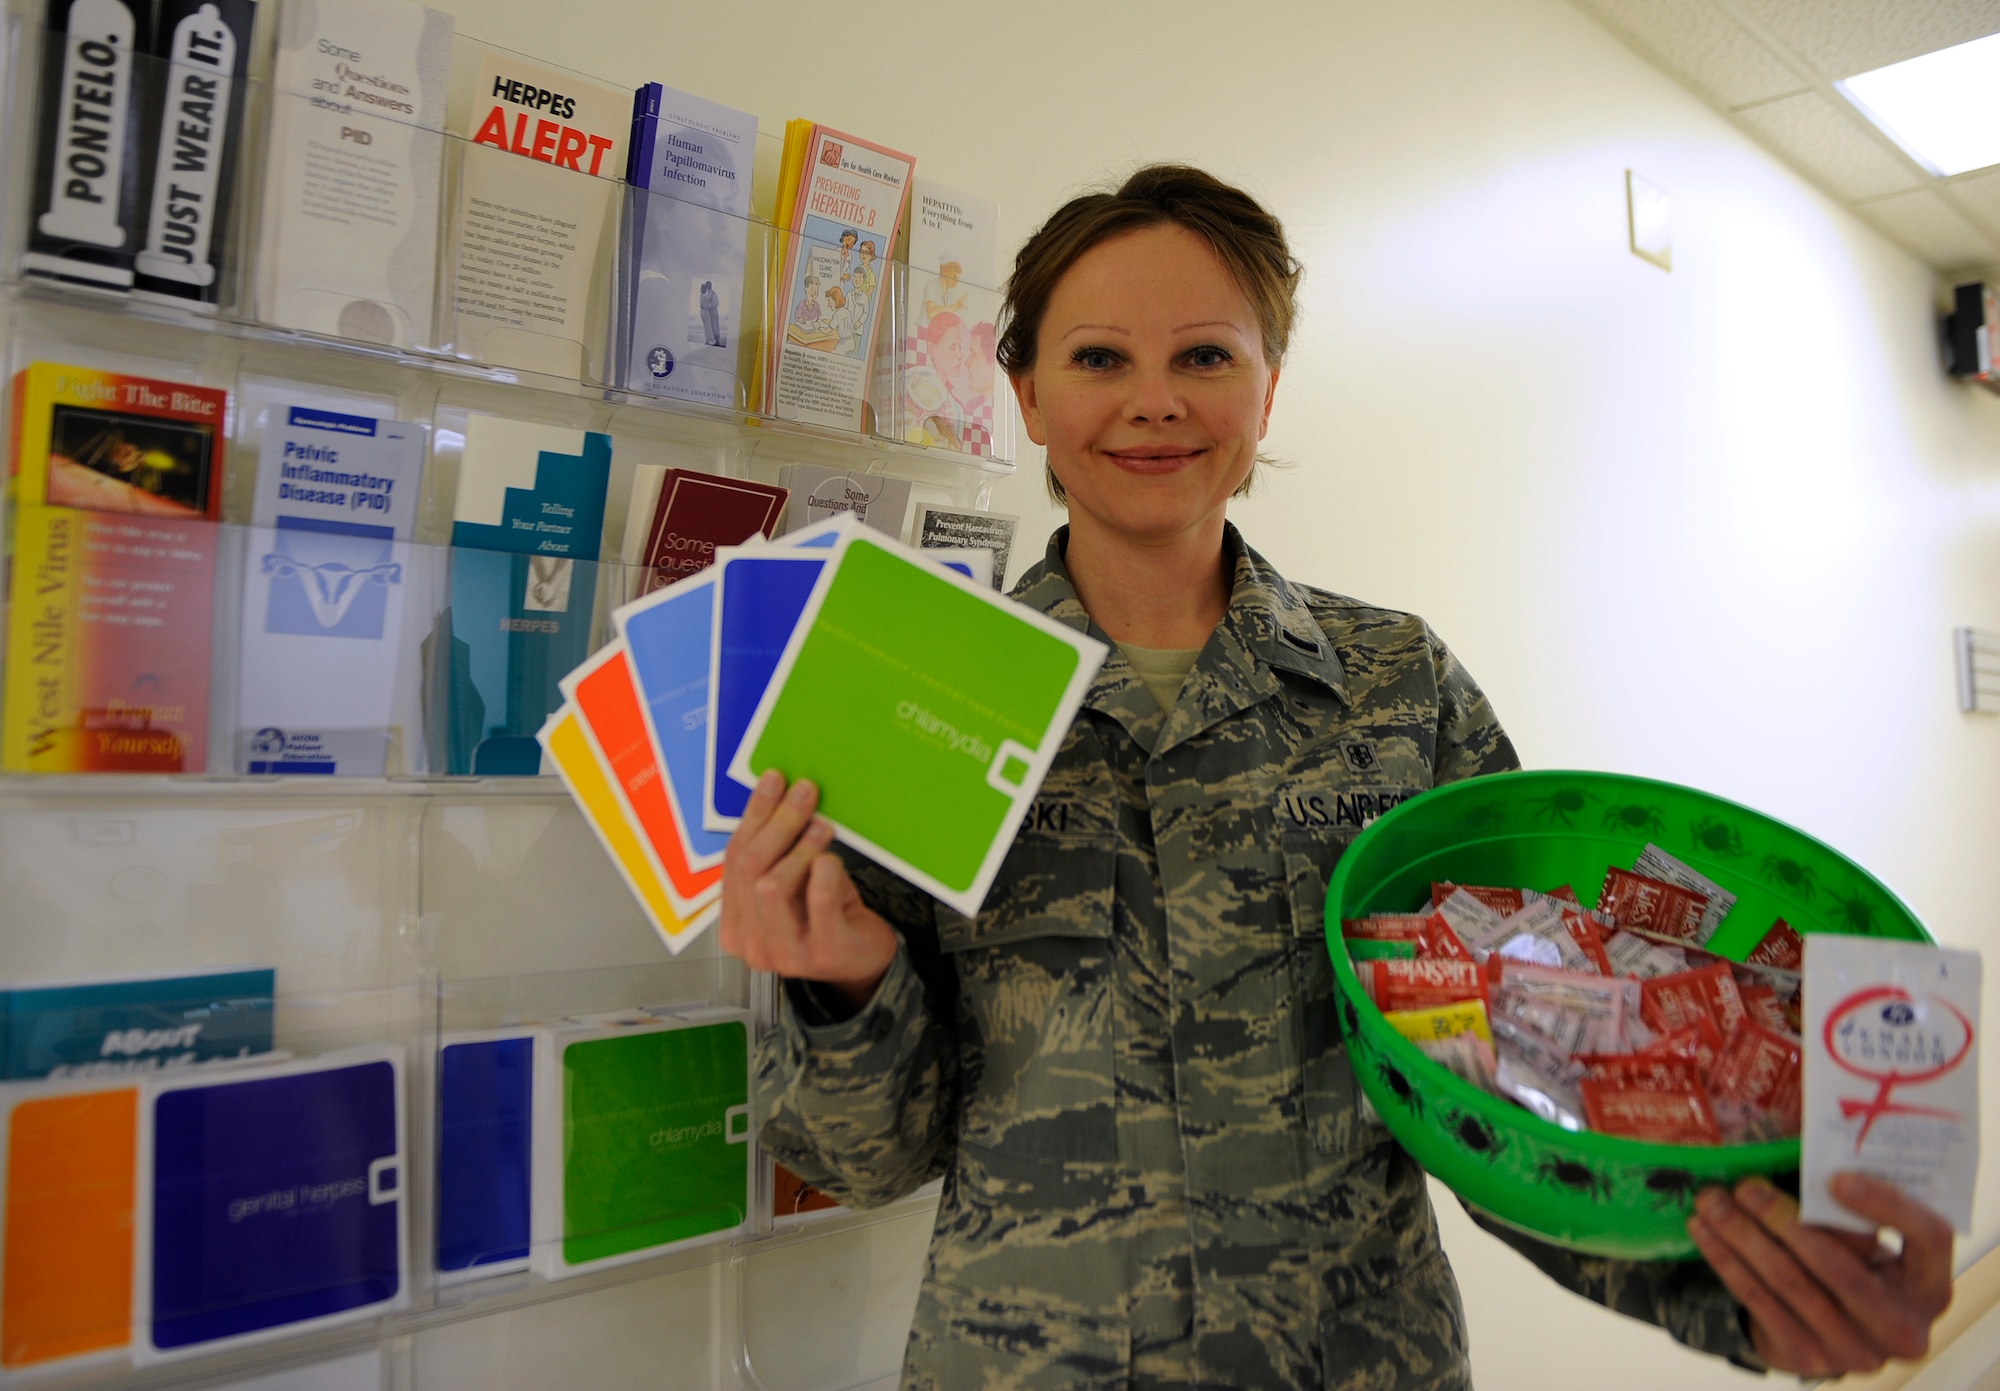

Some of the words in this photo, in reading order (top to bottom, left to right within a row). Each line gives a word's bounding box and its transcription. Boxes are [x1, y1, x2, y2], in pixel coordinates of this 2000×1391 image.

[188, 30, 225, 67] IT.
[318, 39, 361, 62] Some
[335, 63, 411, 95] Questions
[312, 78, 341, 94] and
[344, 85, 414, 114] Answers
[492, 75, 576, 119] HERPES
[67, 34, 121, 204] PONTELO.
[171, 74, 217, 172] WEAR
[341, 126, 372, 146] PID
[473, 105, 613, 177] ALERT
[667, 134, 703, 154] Human
[663, 166, 706, 188] Infection
[665, 150, 736, 180] Papillomavirus
[841, 159, 850, 169] Tips
[858, 165, 872, 176] Health
[872, 169, 882, 180] Care
[882, 174, 900, 186] Workers
[815, 175, 861, 201] PREVENTING
[810, 191, 865, 225] HEPATITIS
[867, 208, 876, 228] B
[922, 206, 957, 226] Everything
[958, 219, 974, 230] from
[160, 184, 205, 265] JUST
[122, 383, 168, 408] The
[170, 391, 218, 416] Bite
[283, 441, 339, 464] Pelvic
[280, 462, 395, 495] Inflammatory
[278, 482, 347, 506] Disease
[351, 491, 391, 514] (PID)
[807, 494, 849, 512] Questions
[850, 501, 868, 515] And
[844, 487, 870, 503] Some
[541, 502, 575, 519] Telling
[512, 518, 535, 531] Your
[535, 520, 572, 535] Partner
[935, 518, 964, 532] Prevent
[965, 521, 1004, 537] Hantavirus
[538, 540, 569, 553] About
[664, 532, 716, 555] Some
[928, 530, 968, 548] Pulmonary
[969, 536, 1006, 551] Syndrome
[499, 618, 561, 634] HERPES
[896, 700, 993, 764] chlamydia
[649, 1118, 723, 1148] chlamydia
[228, 1182, 297, 1224] genital
[299, 1175, 368, 1208] herpes
